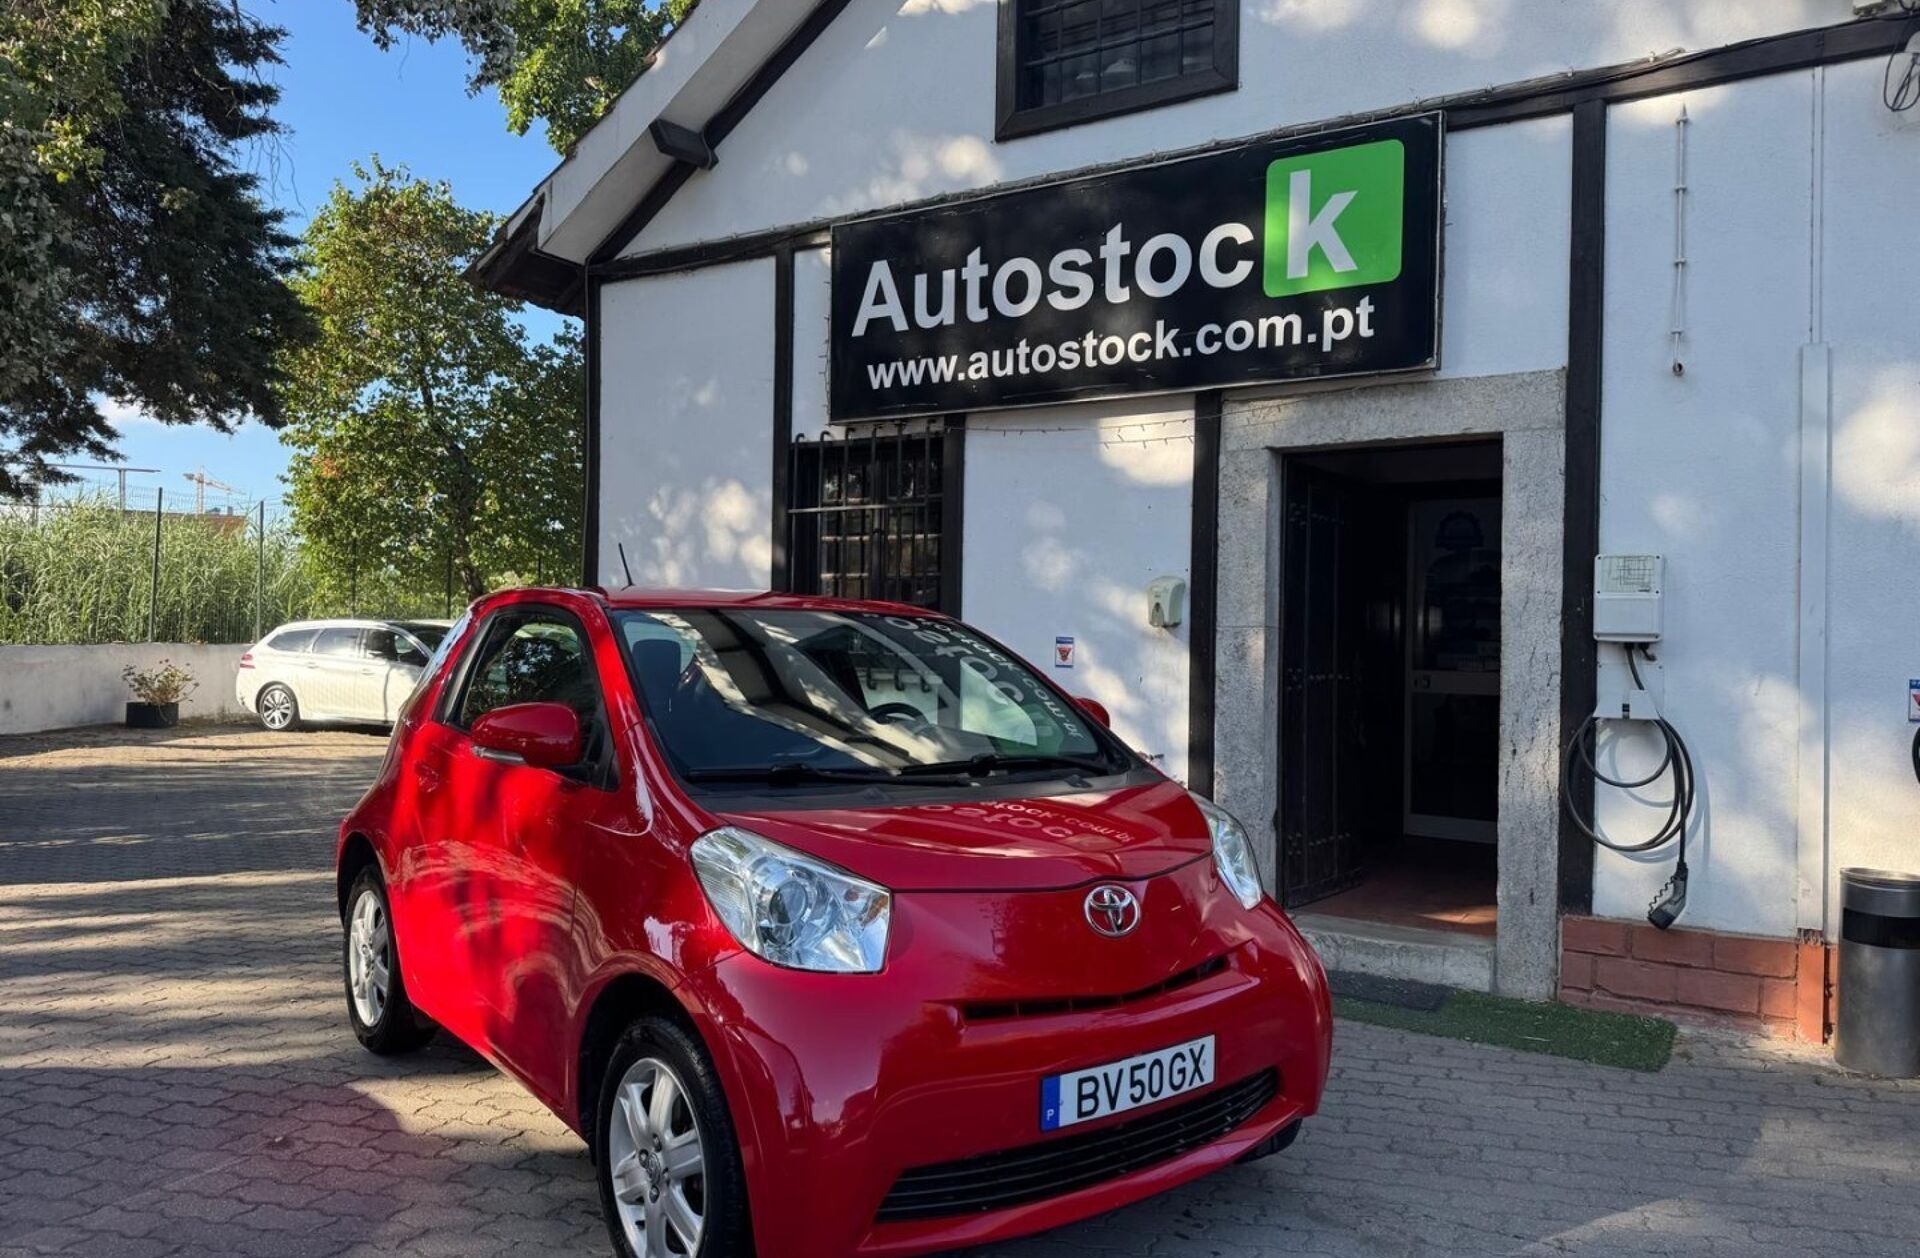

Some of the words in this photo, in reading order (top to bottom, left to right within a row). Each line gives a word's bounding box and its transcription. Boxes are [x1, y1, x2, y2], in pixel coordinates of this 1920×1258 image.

[851, 168, 1359, 338] Autostock
[867, 296, 1375, 390] www.autostock.com.pt
[1046, 1108, 1055, 1121] P
[1077, 1044, 1206, 1119] BV50GX
